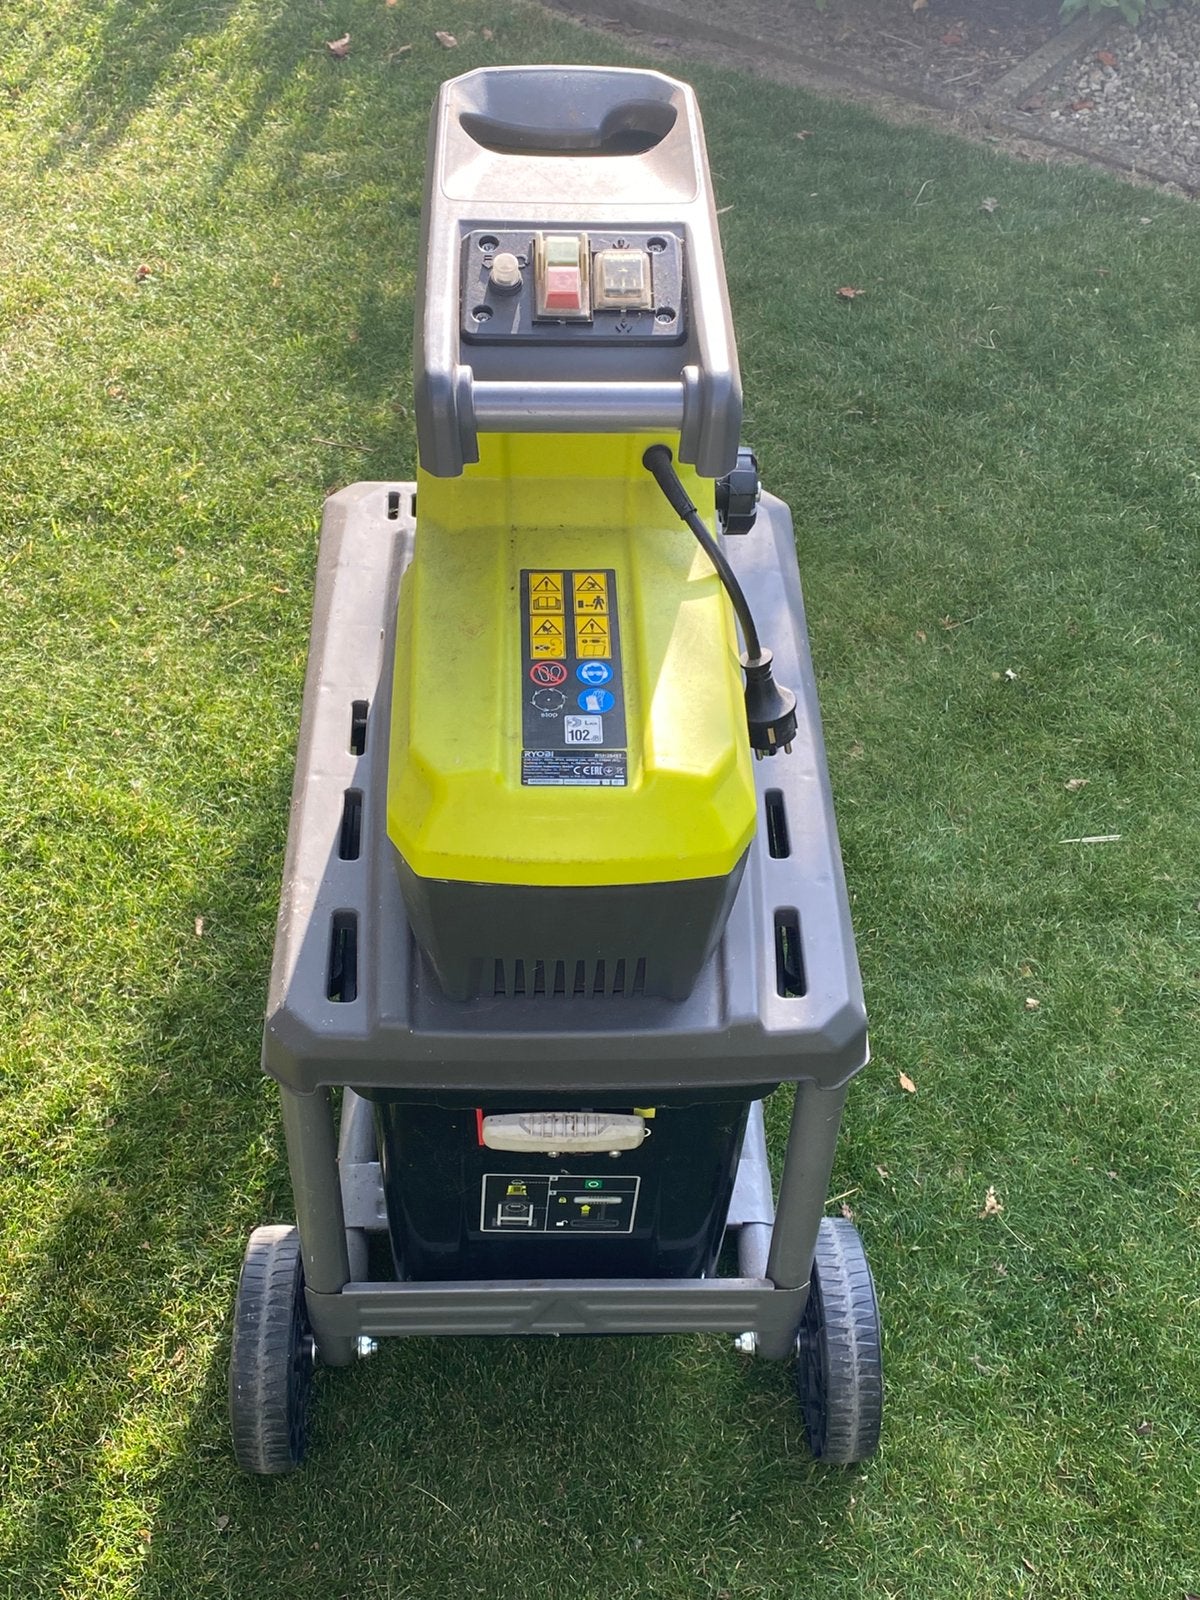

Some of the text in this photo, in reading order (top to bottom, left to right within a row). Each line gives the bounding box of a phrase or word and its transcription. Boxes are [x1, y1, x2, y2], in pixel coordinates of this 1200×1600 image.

[568, 729, 590, 741] 102
[524, 750, 554, 758] RYOBI
[573, 765, 590, 775] CE
